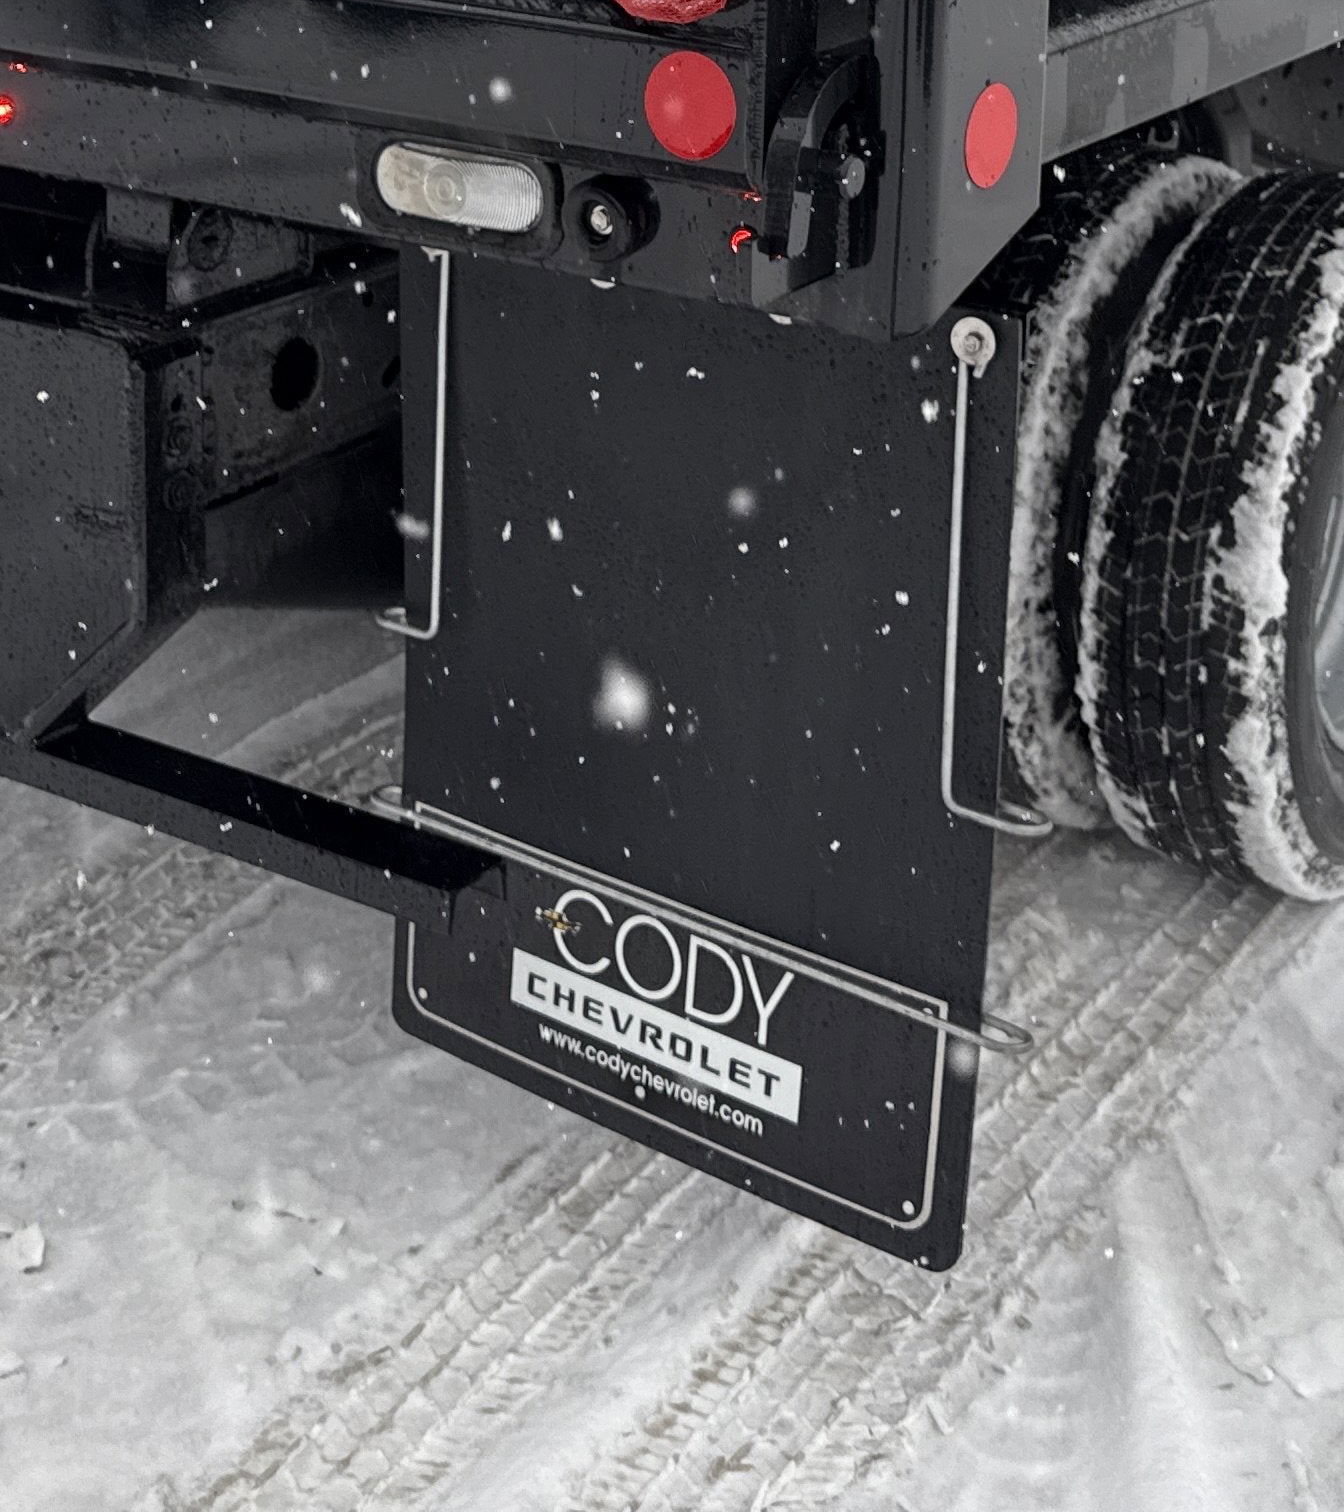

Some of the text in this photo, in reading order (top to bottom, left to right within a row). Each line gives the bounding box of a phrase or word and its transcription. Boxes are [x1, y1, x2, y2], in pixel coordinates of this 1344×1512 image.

[553, 888, 795, 1047] CODY
[527, 970, 781, 1098] CHEVROLET
[538, 1023, 764, 1137] www.codychevrolet.com
